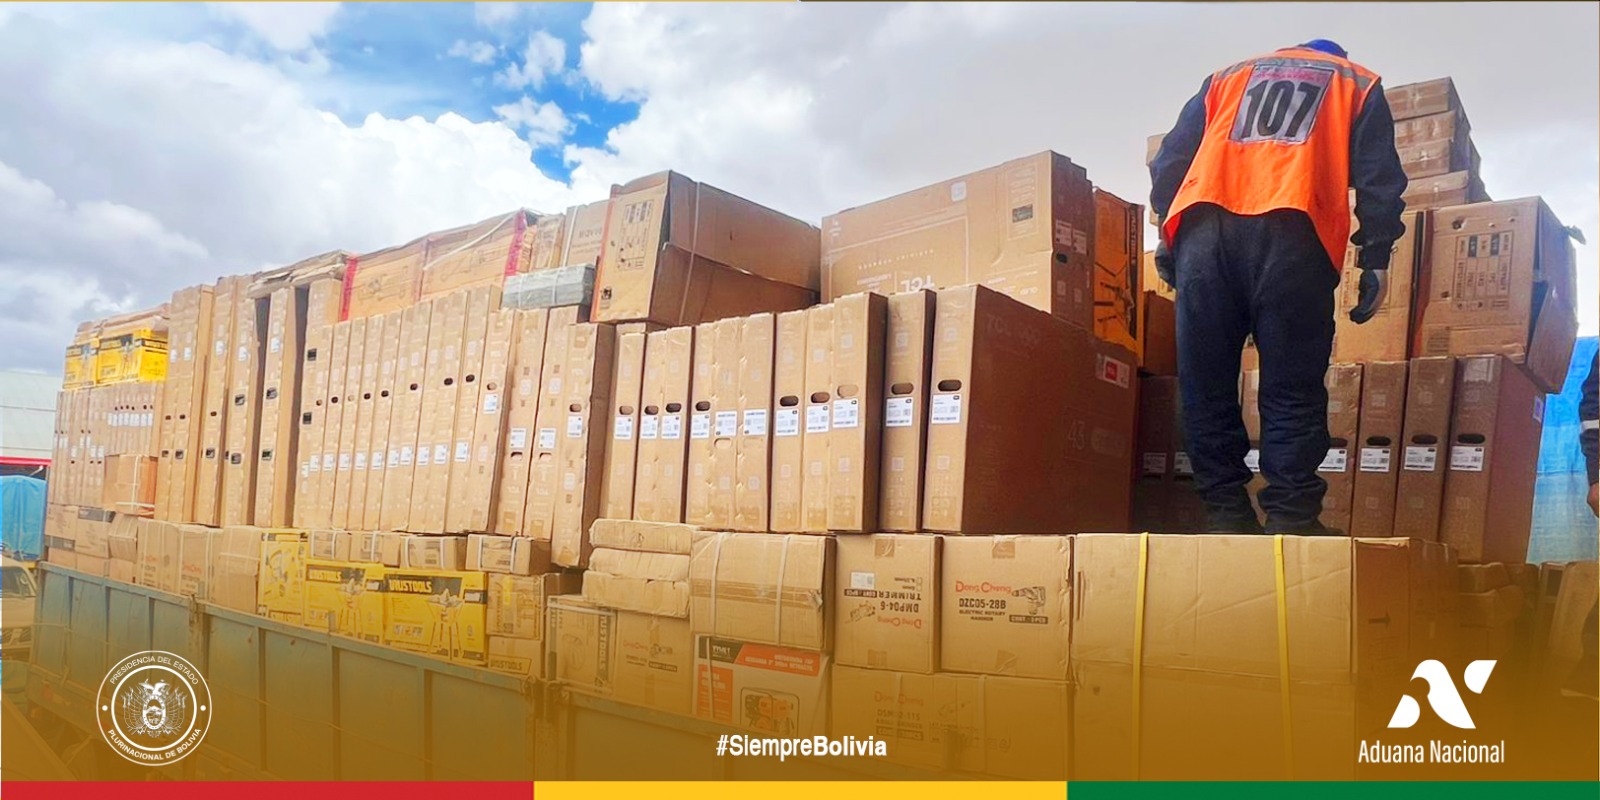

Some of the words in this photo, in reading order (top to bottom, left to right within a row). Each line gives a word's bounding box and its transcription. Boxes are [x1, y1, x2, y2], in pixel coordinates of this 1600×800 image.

[1240, 80, 1322, 139] 107
[955, 580, 980, 593] Dong
[981, 581, 1012, 594] Cheng
[878, 590, 922, 601] TRIMMER
[879, 601, 919, 613] DMP04-6
[958, 598, 1007, 610] DZC05-28B
[876, 708, 921, 722] DSM2-115
